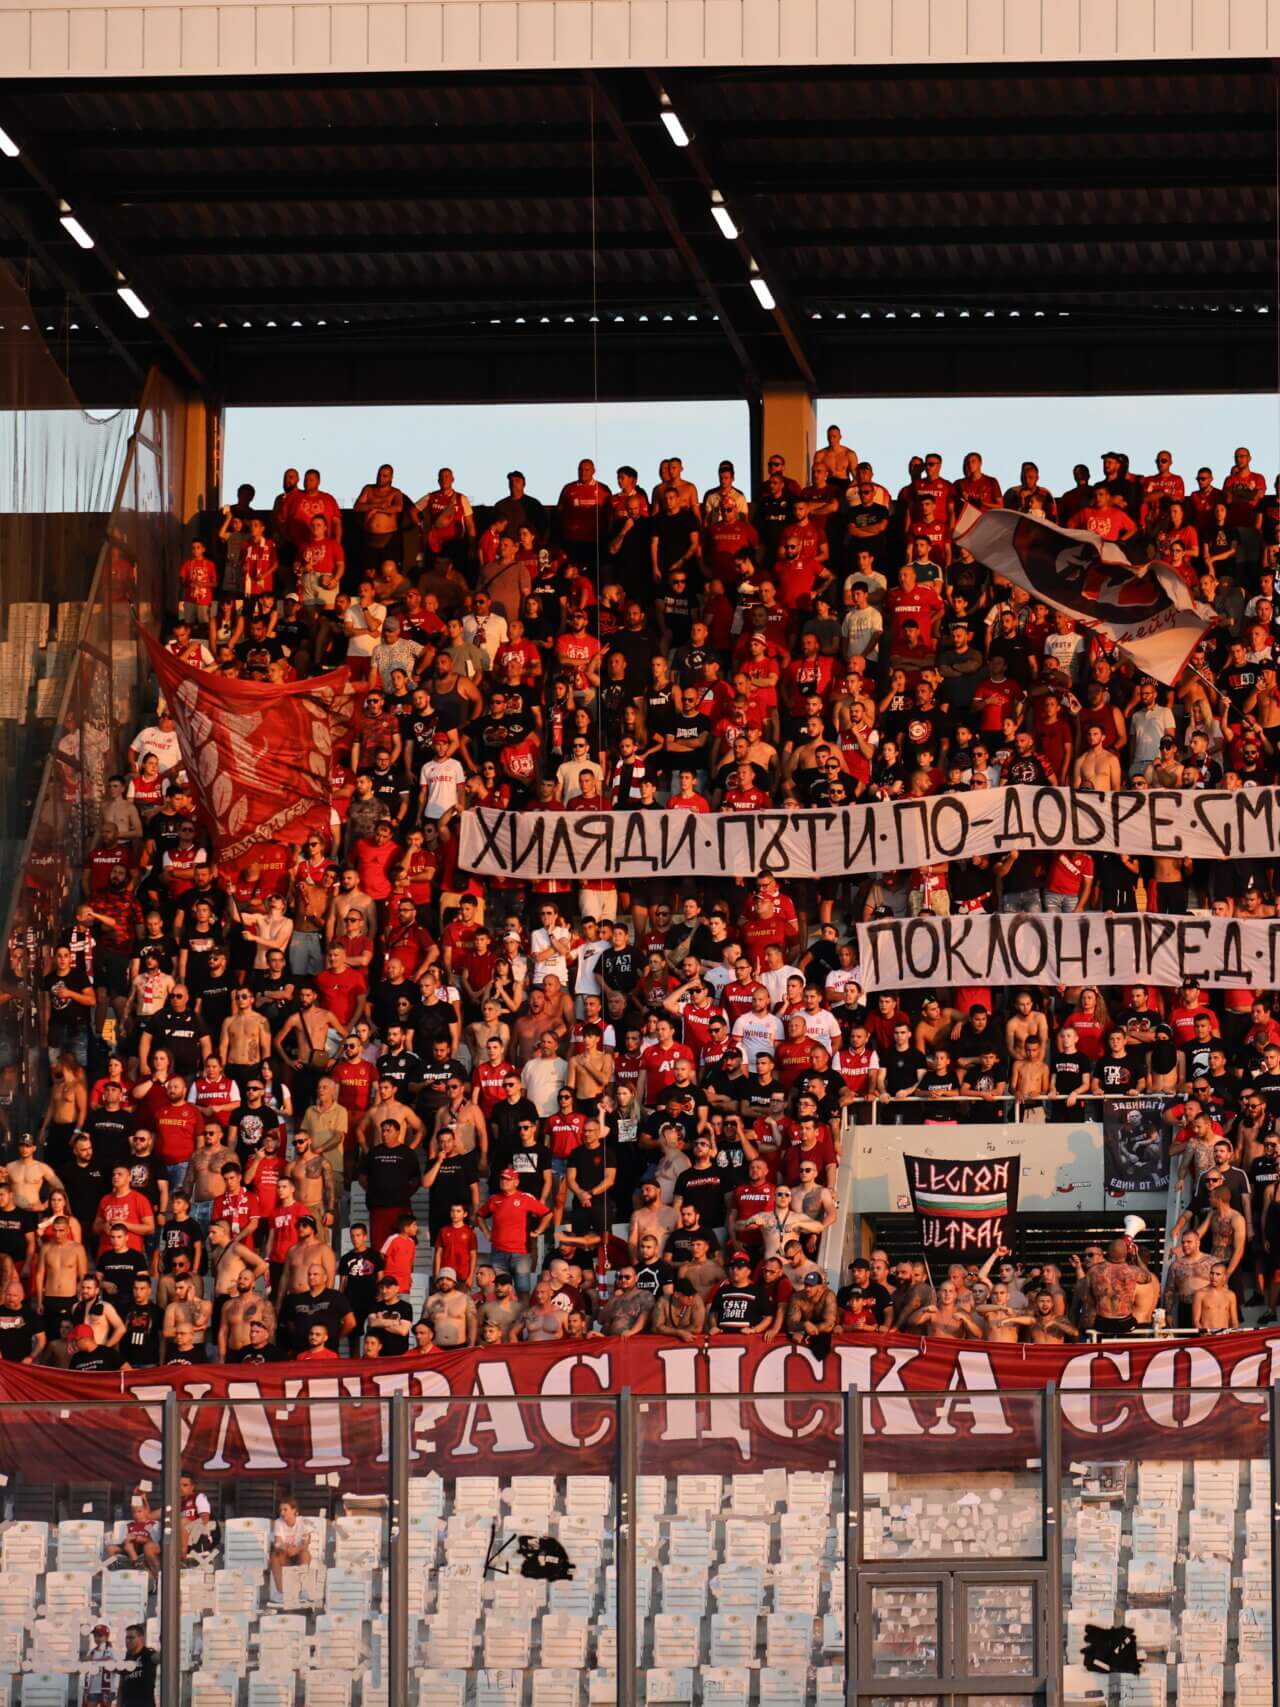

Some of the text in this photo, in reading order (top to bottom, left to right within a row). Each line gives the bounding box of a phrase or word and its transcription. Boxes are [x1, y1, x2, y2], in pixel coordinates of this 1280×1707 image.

[473, 806, 697, 873] ХИЛЯДИ
[717, 806, 876, 873] ПЪТИ
[867, 915, 1089, 984] ПОКЛОН
[1105, 915, 1252, 985] ПРЕД
[1110, 1178, 1135, 1190] ЕДИН
[1140, 1181, 1151, 1190] ОТ
[922, 1217, 1003, 1250] ULTRAS
[129, 1352, 611, 1471] УЛТРАС
[657, 1345, 1014, 1461] ЦСКА
